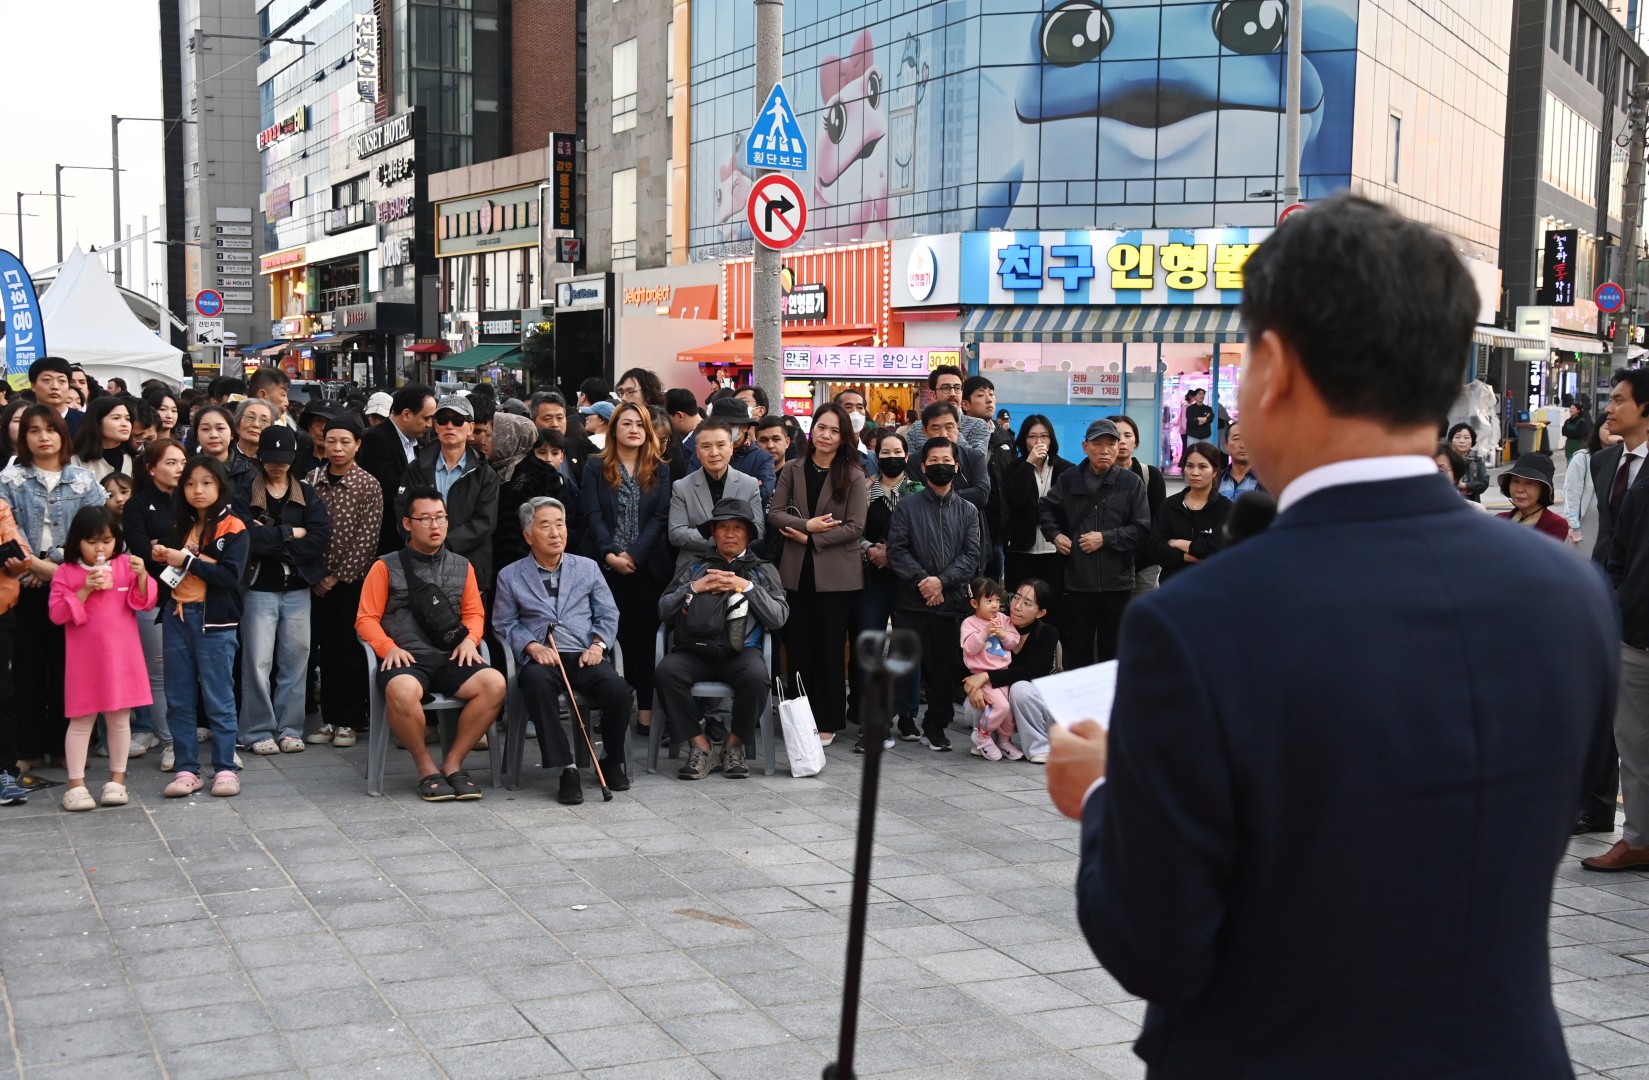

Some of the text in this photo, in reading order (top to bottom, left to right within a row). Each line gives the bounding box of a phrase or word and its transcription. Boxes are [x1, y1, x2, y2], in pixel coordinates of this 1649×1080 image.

[358, 17, 376, 103] 선셋호텔
[356, 115, 409, 156] SUNSET HOTEL
[753, 151, 803, 168] 횡단보도
[383, 239, 401, 267] OPUS
[564, 240, 578, 262] 7
[997, 243, 1095, 290] 친구
[909, 272, 931, 287] 인형뽑기
[3, 269, 36, 352] 다회용기
[786, 352, 809, 363] 한국
[882, 353, 924, 369] 할인샵
[1073, 374, 1119, 383] 천원 2게임
[1072, 386, 1119, 395] 오백원 1게임
